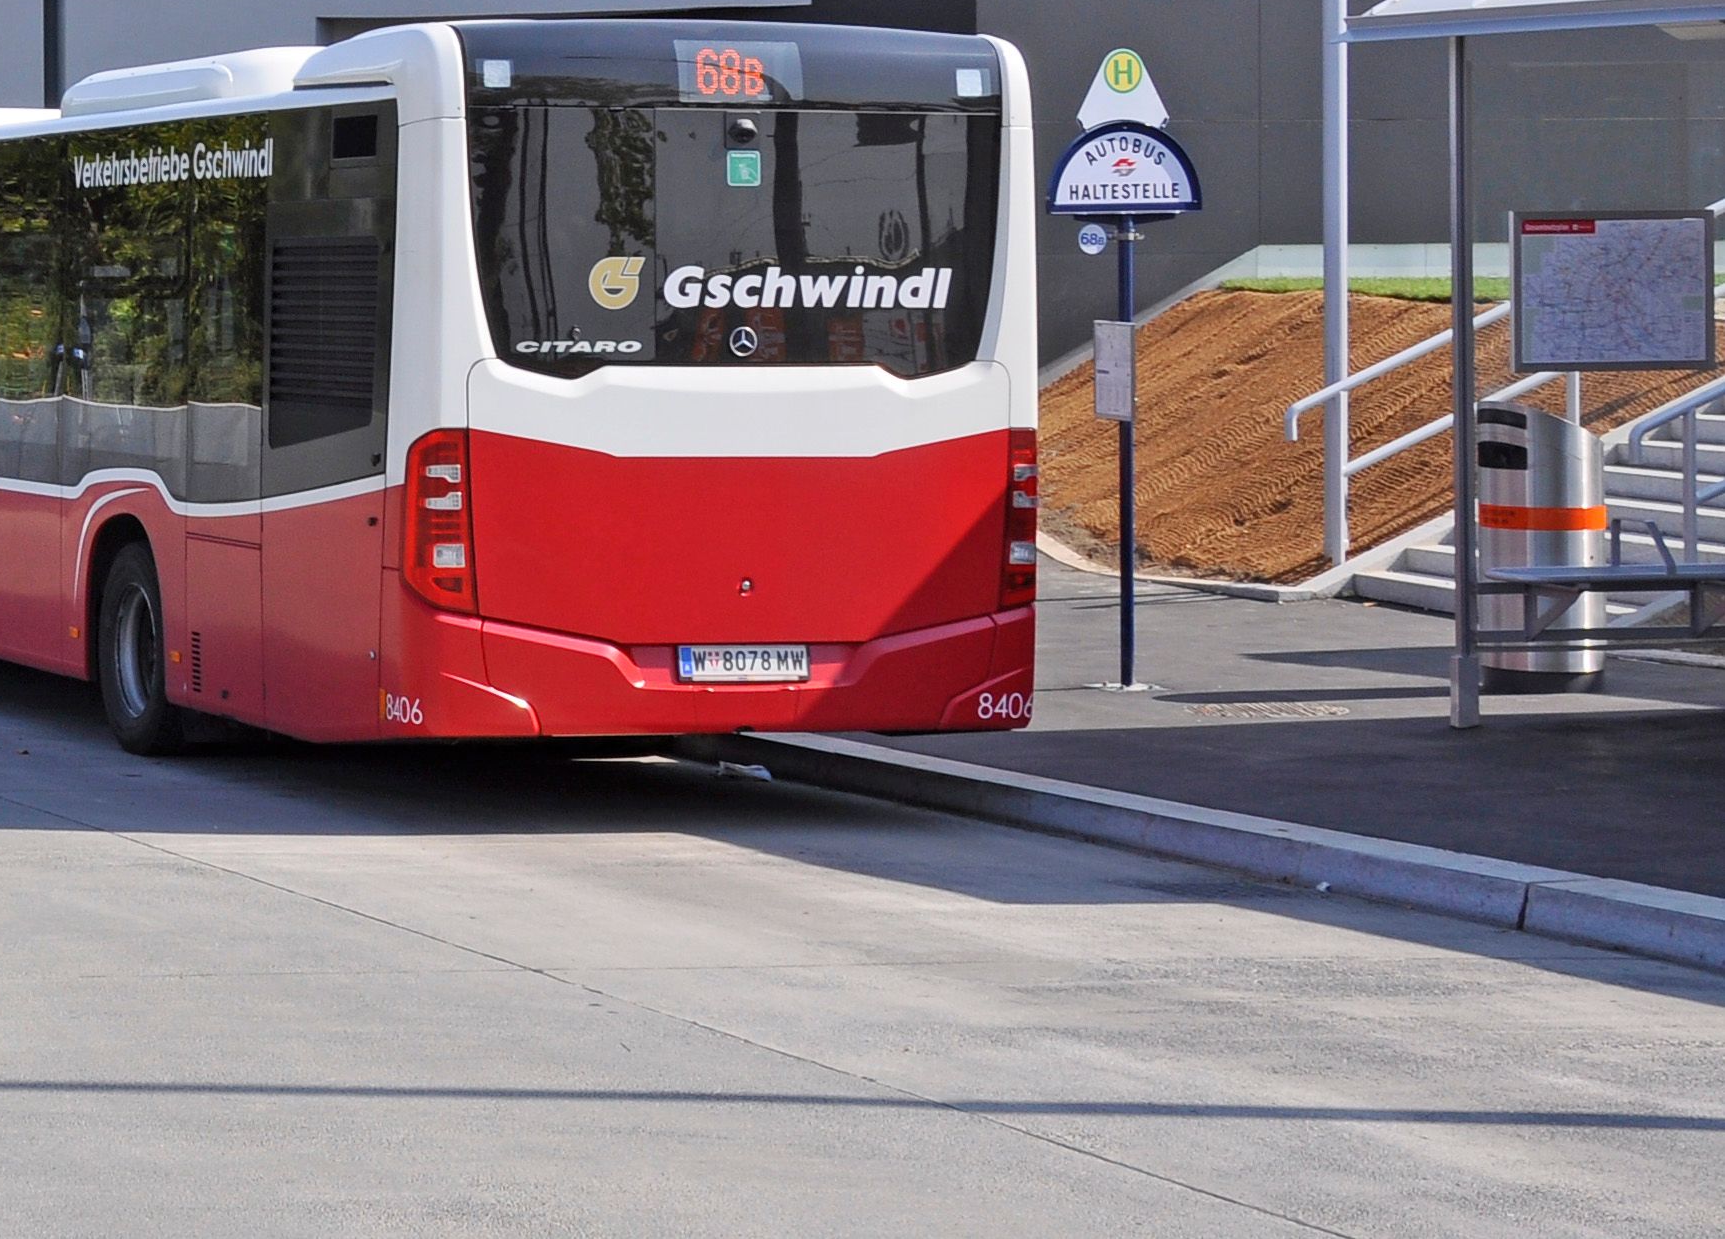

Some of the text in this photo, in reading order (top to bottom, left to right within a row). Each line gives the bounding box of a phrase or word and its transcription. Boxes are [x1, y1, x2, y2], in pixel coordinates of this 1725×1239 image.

[696, 47, 764, 96] 68B
[1112, 59, 1134, 86] H
[74, 138, 274, 189] Verkehrsbetriebe Gschwindl
[1084, 136, 1166, 166] AUTOBUS
[1069, 182, 1180, 201] HALTESTELLE
[663, 265, 953, 309] Gschwindl
[515, 340, 643, 354] CITARO
[692, 649, 804, 672] W 8078 MW
[385, 693, 424, 725] 8406
[977, 692, 1034, 719] 8406
